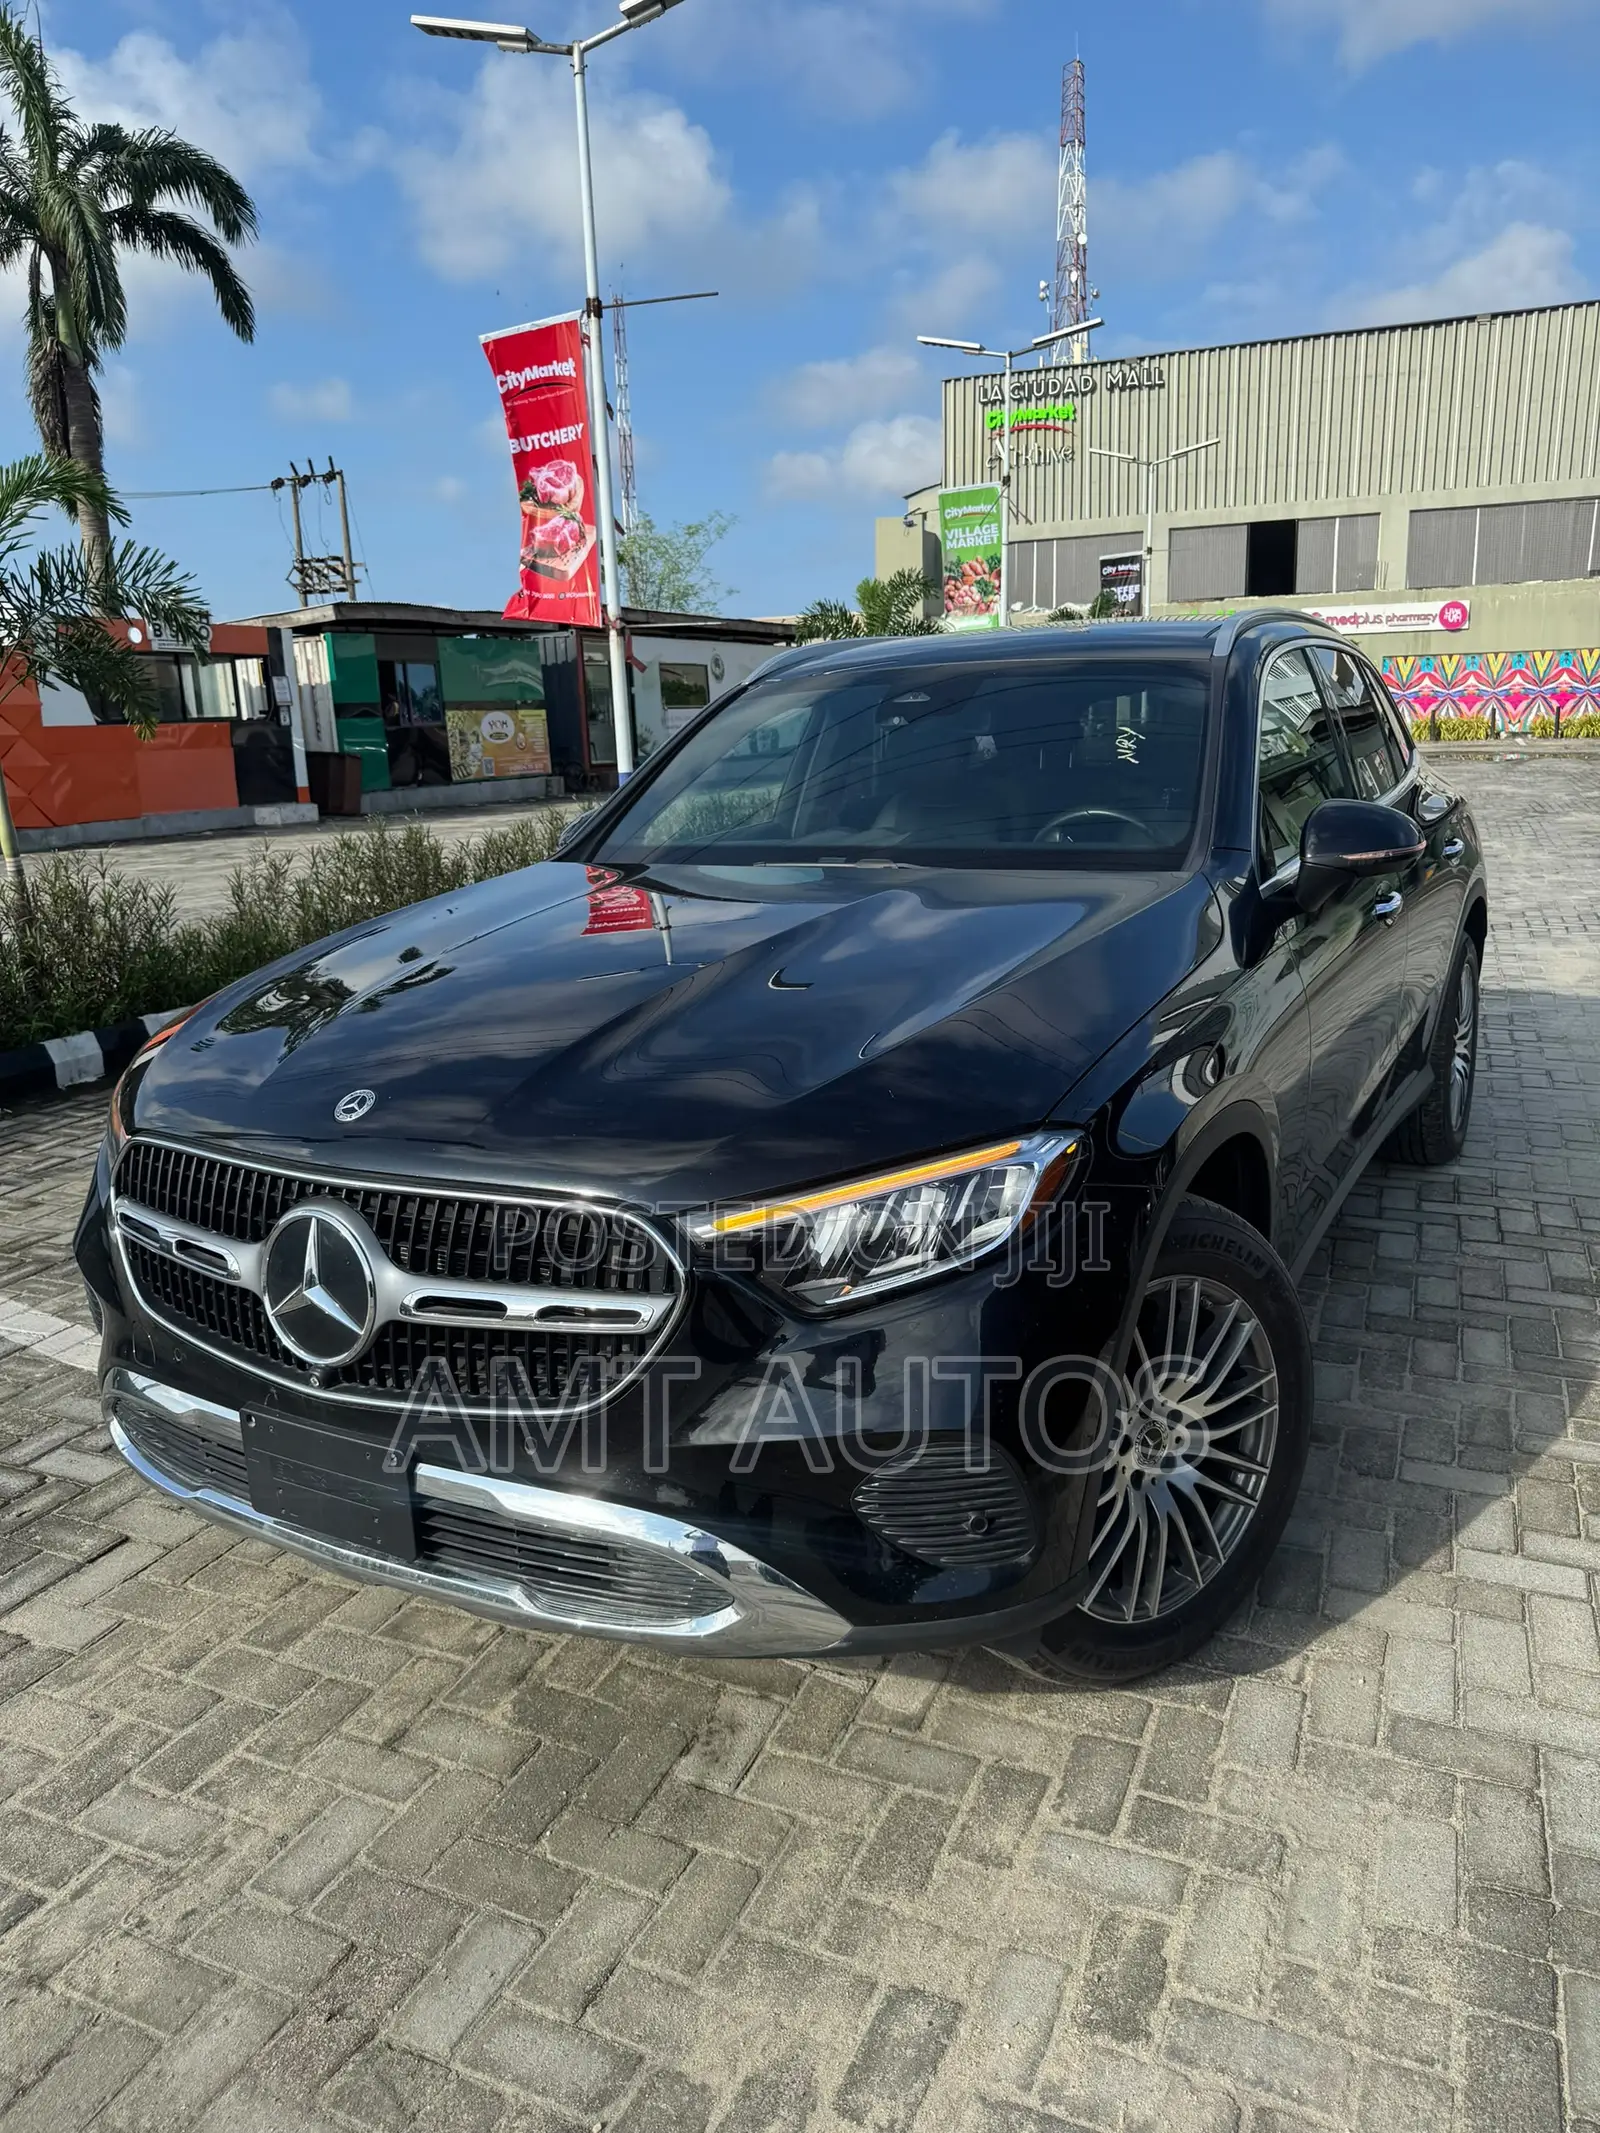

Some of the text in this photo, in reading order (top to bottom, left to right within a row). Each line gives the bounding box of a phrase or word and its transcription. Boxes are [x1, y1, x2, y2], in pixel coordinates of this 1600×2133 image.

[496, 357, 577, 394] CityMarket
[979, 366, 1165, 403] LA CIUDAD MALL
[985, 402, 1076, 430] CiyMarket
[508, 422, 584, 454] BUTCHERY
[945, 523, 999, 540] VILLAGE
[946, 534, 999, 551] MARKET
[1102, 565, 1116, 575] City
[1326, 611, 1438, 629] medplus pharmacy
